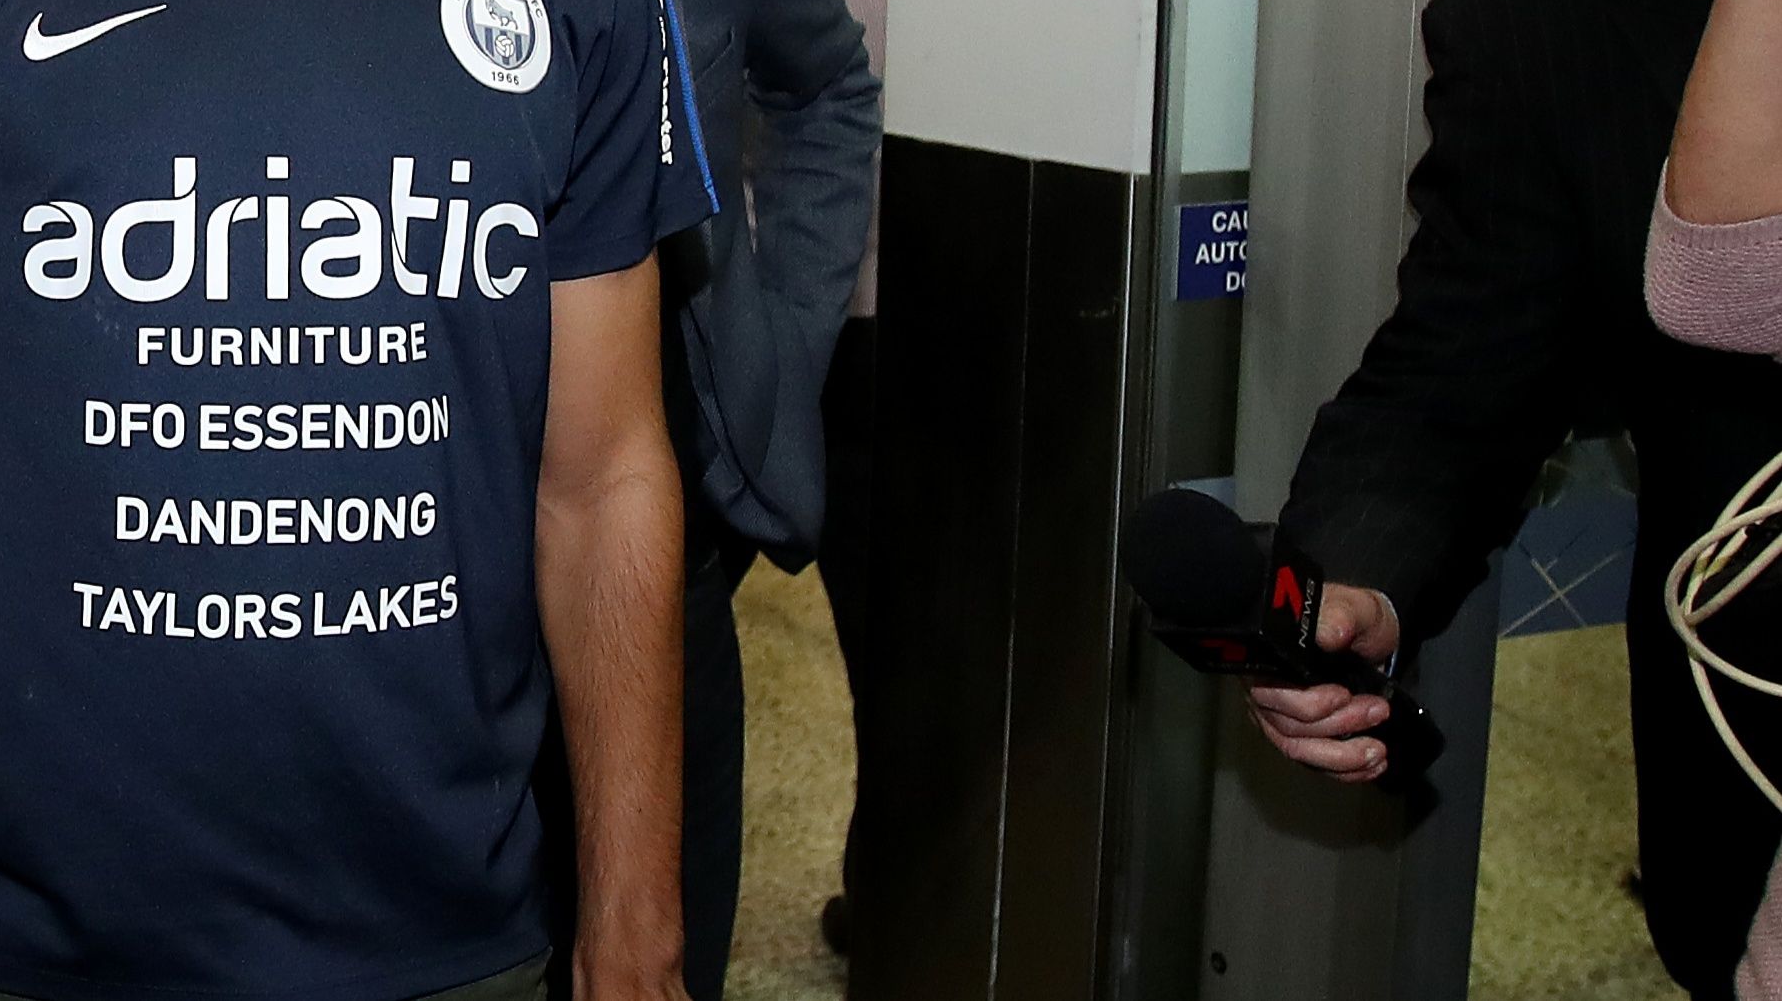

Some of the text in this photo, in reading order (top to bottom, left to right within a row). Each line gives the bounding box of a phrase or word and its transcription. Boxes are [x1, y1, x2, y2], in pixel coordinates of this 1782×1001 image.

[531, 0, 544, 19] FC
[491, 71, 520, 86] 1966
[23, 156, 539, 302] adriatic
[138, 322, 427, 365] FURNITURE
[84, 395, 449, 450] DFO ESSENDON
[116, 492, 436, 545] DANDENONG
[73, 575, 457, 639] TAYLORS LAKES
[1298, 578, 1316, 649] NEWS
